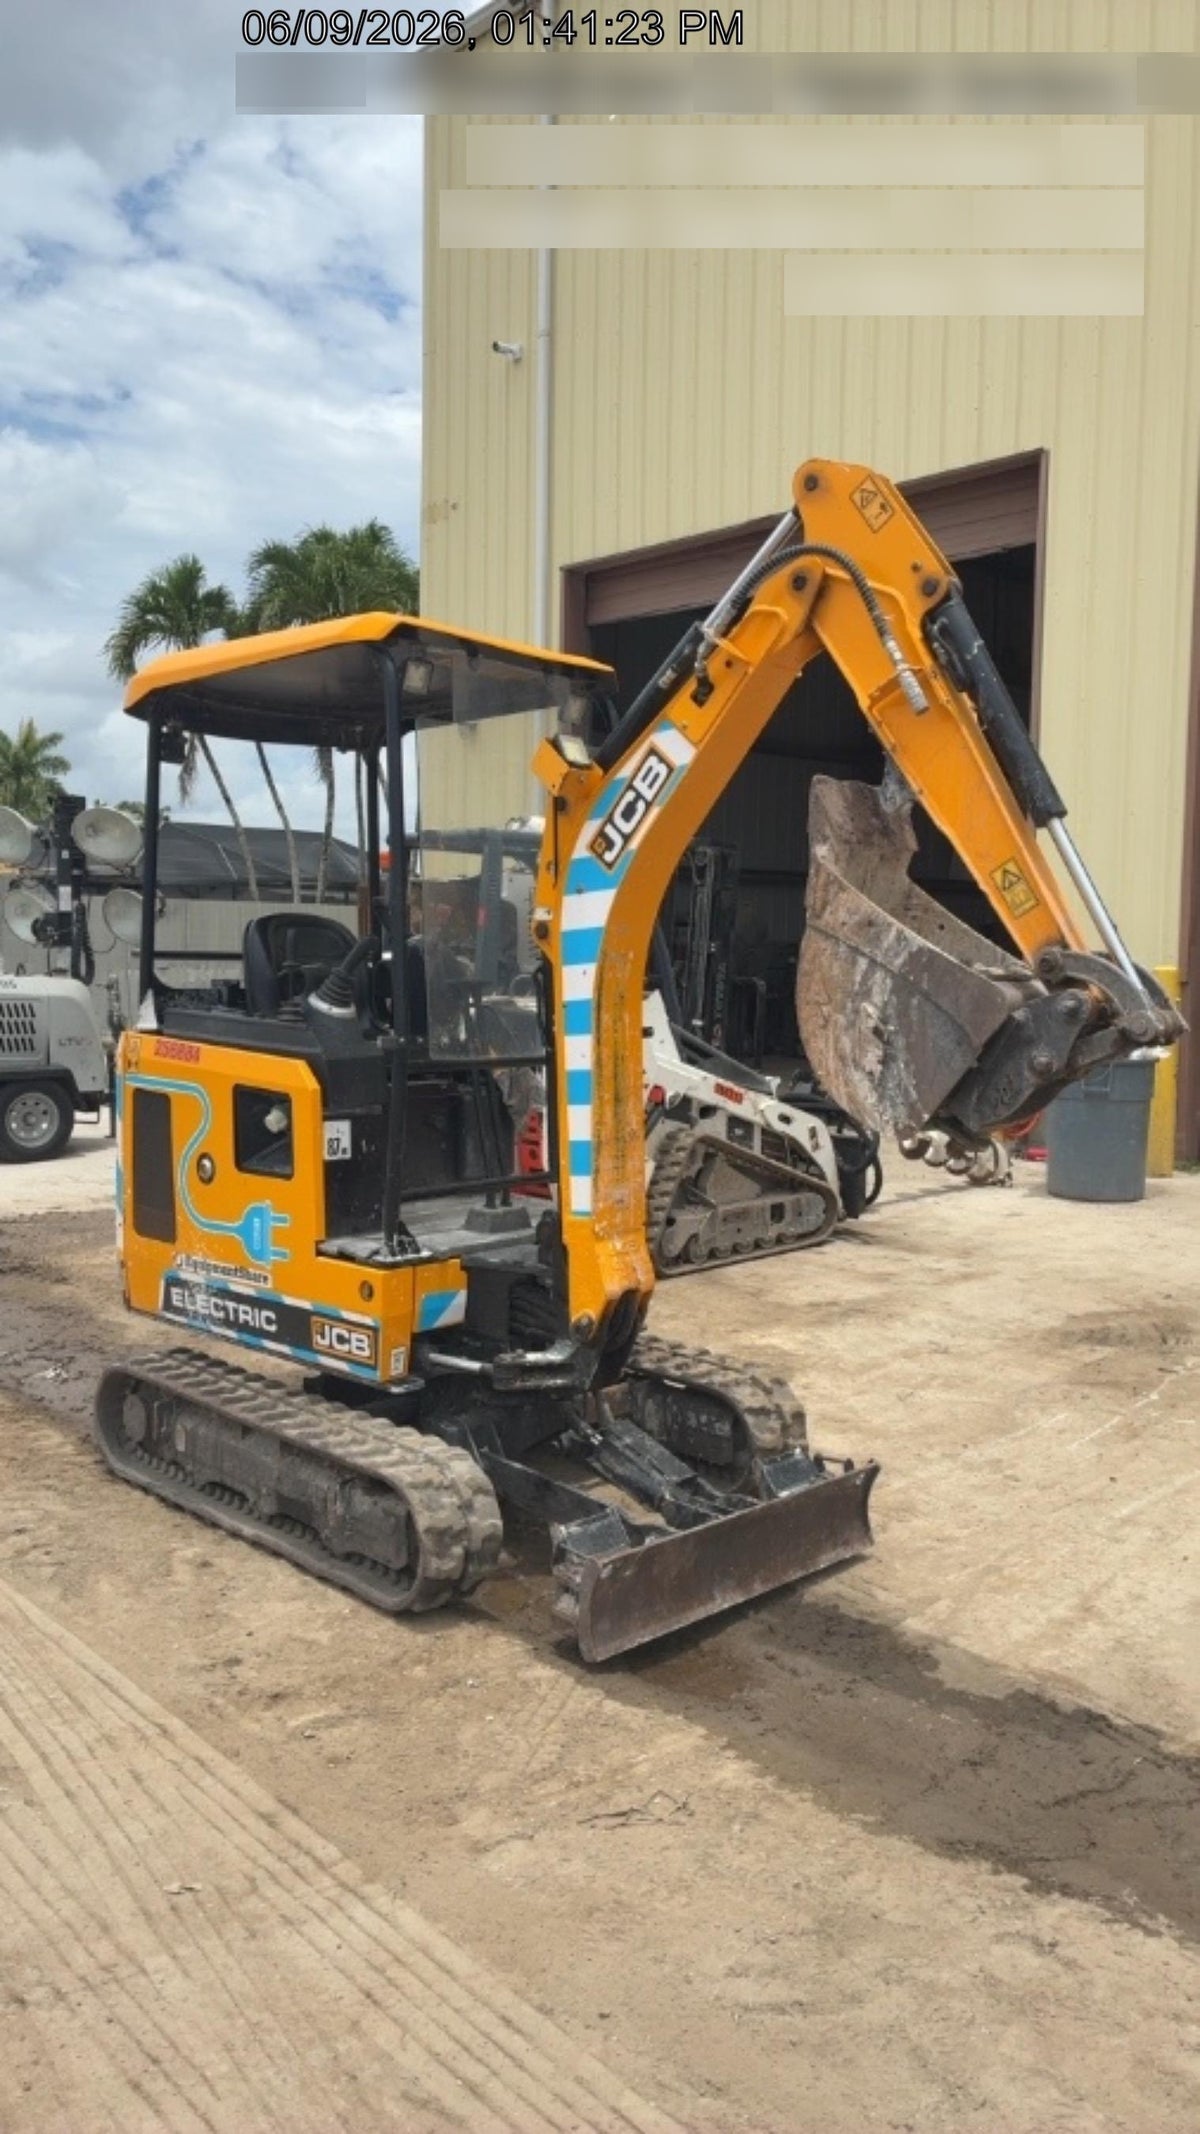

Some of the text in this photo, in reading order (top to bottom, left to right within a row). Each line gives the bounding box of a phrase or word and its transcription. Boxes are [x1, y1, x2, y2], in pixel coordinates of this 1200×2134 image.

[604, 754, 670, 864] JCB
[171, 1287, 277, 1332] ELECTRIC
[317, 1325, 370, 1356] JCB
